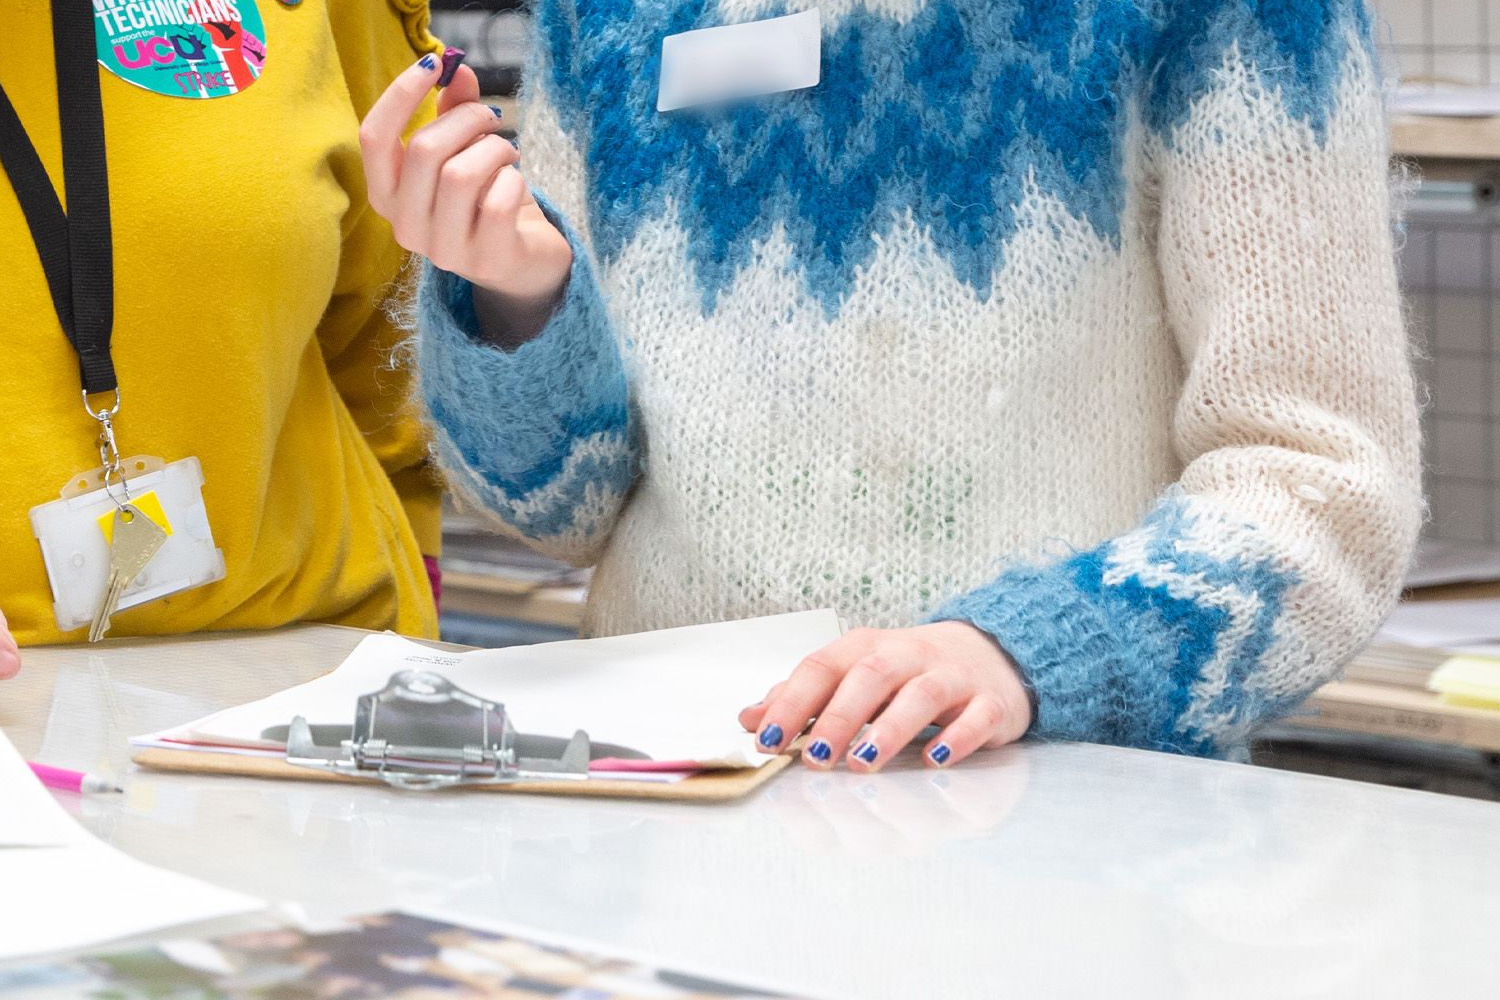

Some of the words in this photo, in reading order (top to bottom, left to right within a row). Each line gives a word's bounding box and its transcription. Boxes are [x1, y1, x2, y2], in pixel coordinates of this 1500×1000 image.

[111, 32, 143, 45] support
[141, 29, 156, 37] the
[173, 70, 235, 94] STRIKE
